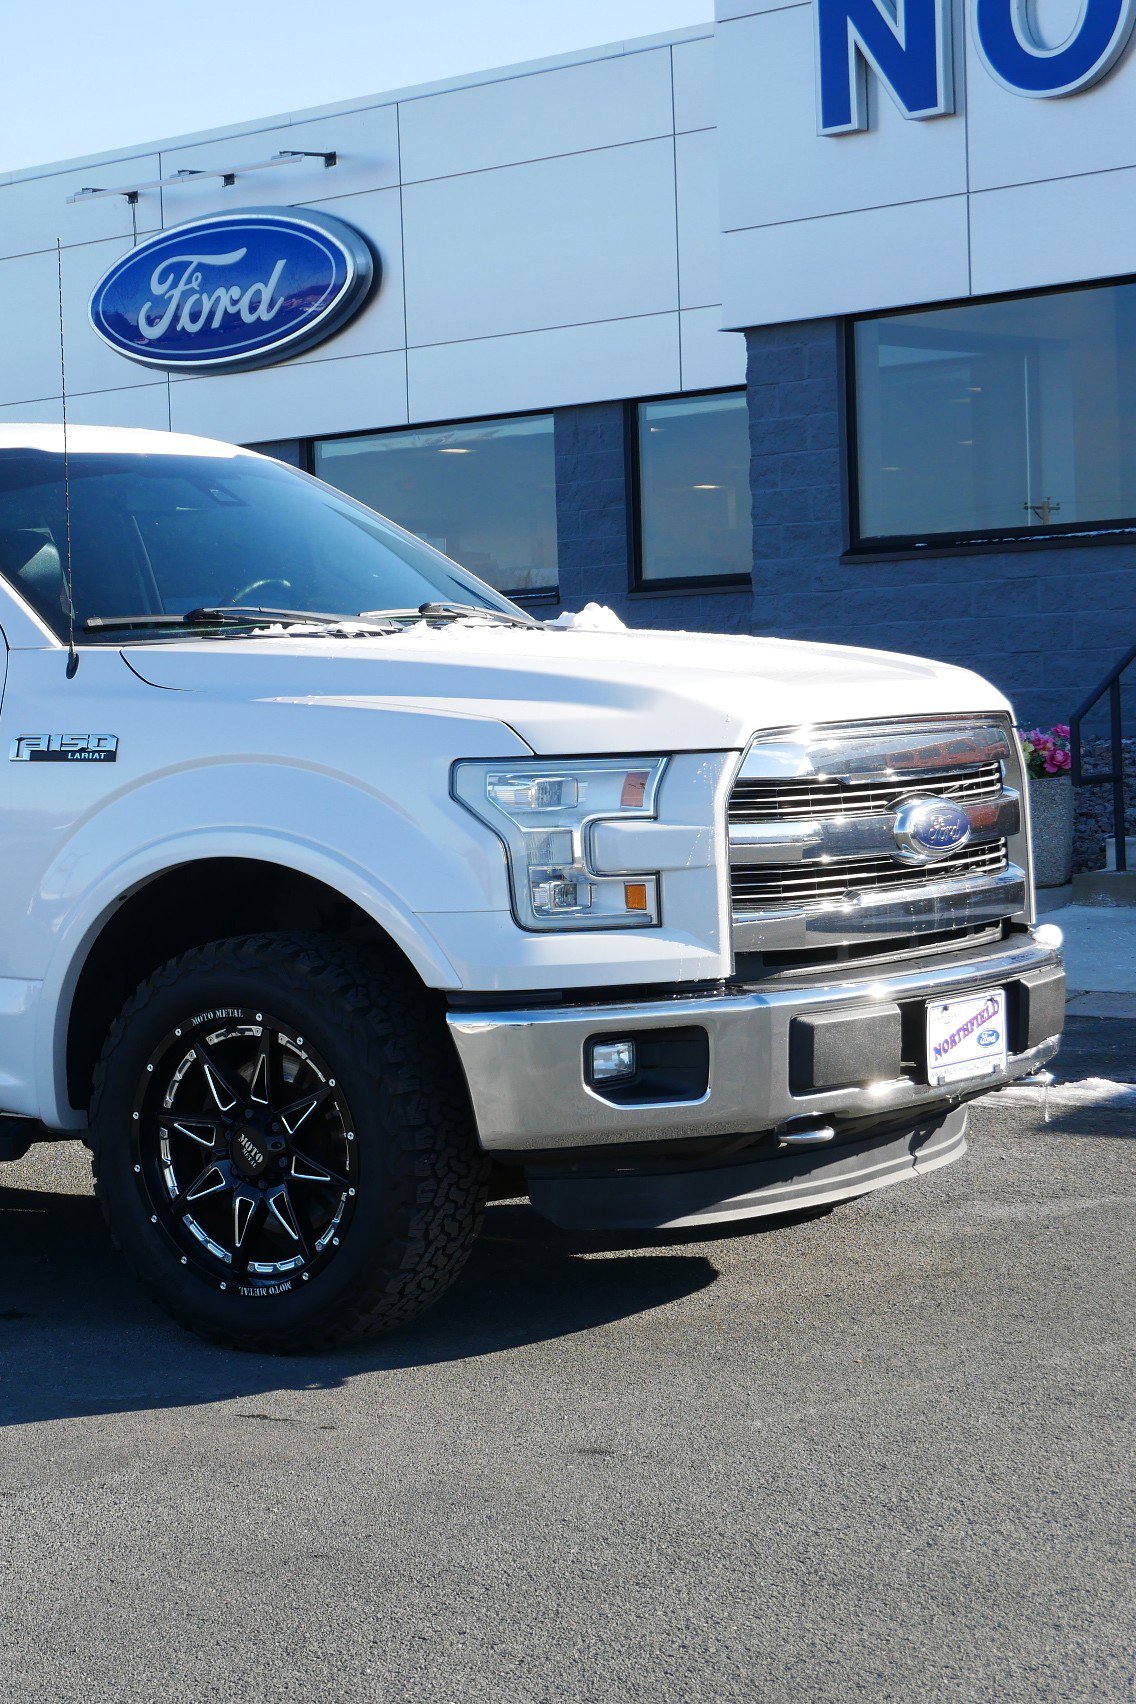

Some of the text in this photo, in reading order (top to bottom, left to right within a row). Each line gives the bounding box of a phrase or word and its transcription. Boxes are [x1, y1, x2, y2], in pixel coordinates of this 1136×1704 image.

[138, 247, 287, 340] Ford
[67, 752, 107, 760] LARIAT
[928, 814, 961, 842] Ford
[191, 1008, 244, 1026] MOTO METAL
[933, 999, 1000, 1061] NORTHFIELD
[238, 1133, 264, 1163] MOTO
[238, 1280, 293, 1297] MOTO METAL
